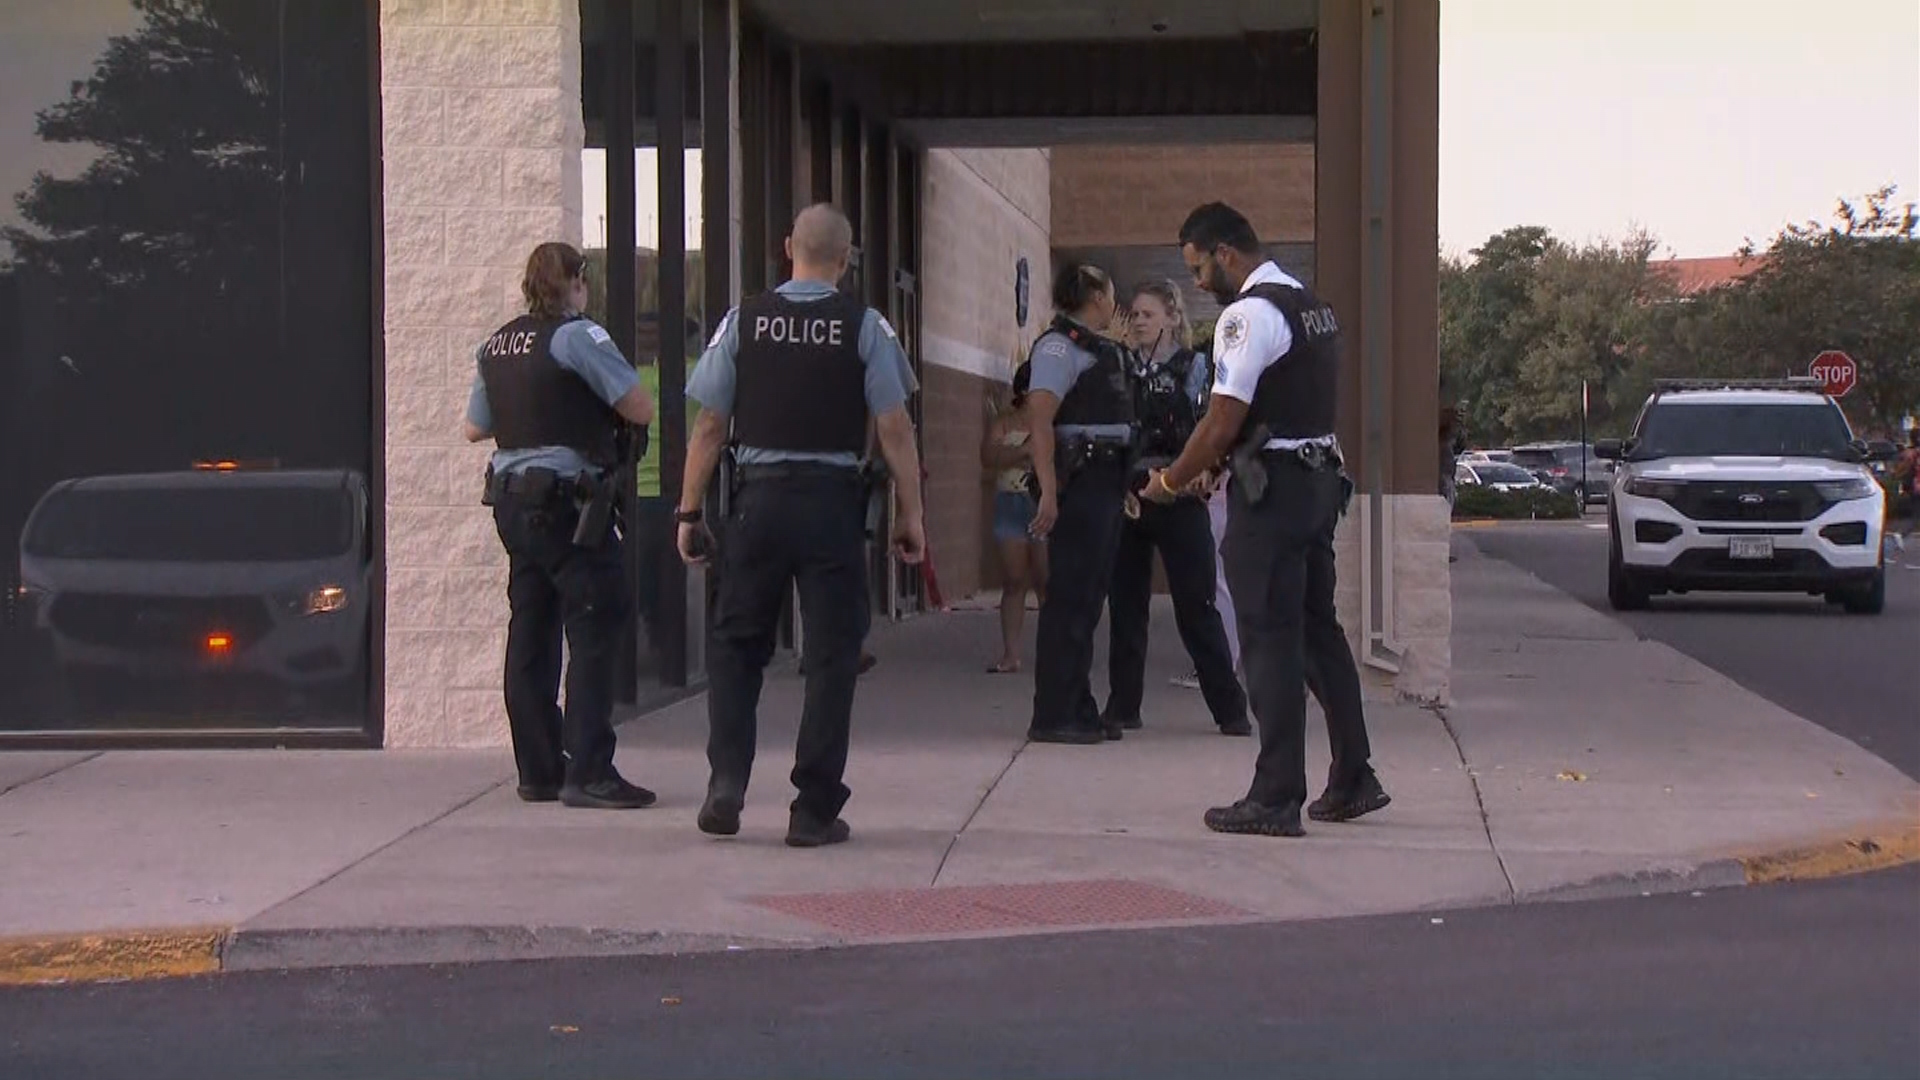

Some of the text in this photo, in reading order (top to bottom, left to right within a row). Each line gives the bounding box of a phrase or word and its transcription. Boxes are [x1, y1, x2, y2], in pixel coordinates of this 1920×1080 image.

[755, 316, 842, 345] POLICE
[1301, 308, 1338, 335] POLIC
[485, 332, 536, 355] POLICE
[1812, 366, 1851, 383] STOP
